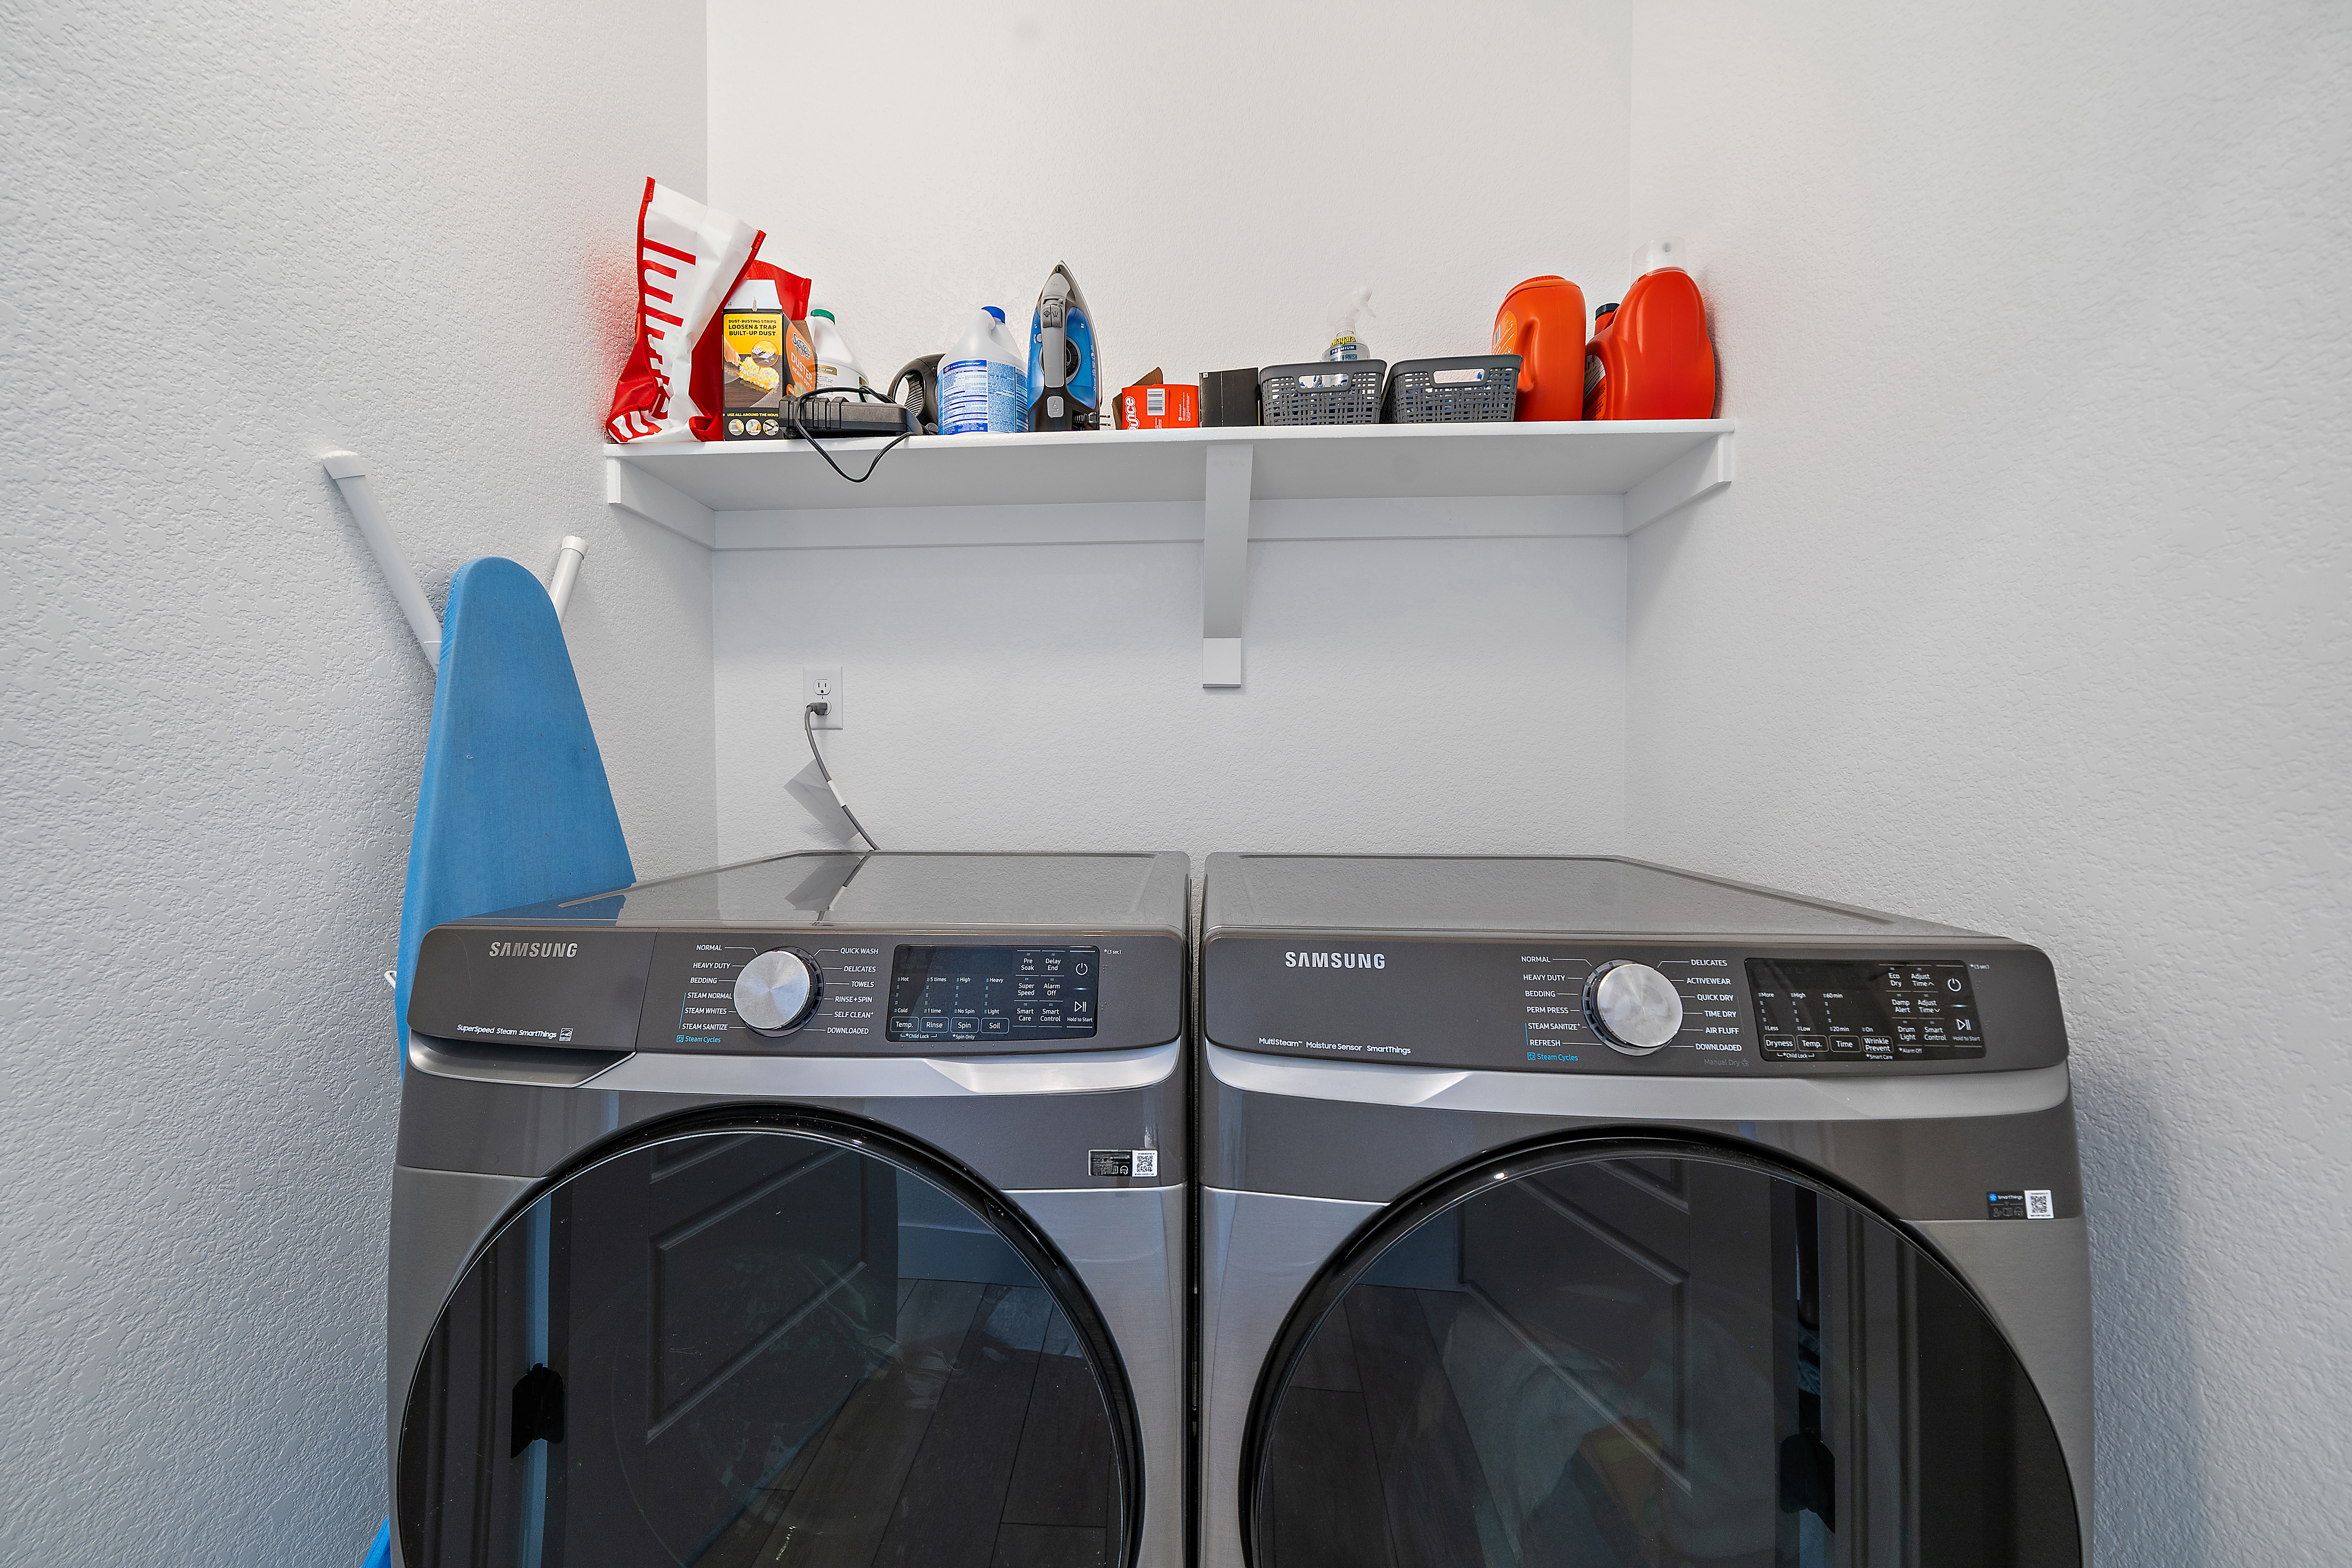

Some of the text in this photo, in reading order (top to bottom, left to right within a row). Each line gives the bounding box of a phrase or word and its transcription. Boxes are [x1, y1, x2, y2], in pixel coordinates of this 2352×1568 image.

[792, 332, 810, 359] Swiffer
[1330, 336, 1356, 348] Niagara
[791, 352, 812, 383] DUSTER
[792, 365, 804, 380] HEAVY
[1125, 397, 1139, 430] unce
[489, 942, 578, 958] SAMSUNG
[1285, 951, 1385, 969] SAMSUNG
[457, 1024, 557, 1040] SuperSpeed Steam SmartThings
[1306, 1041, 1337, 1050] Moisture
[1338, 1043, 1362, 1051] Sensor
[1367, 1045, 1411, 1055] SmartThings
[1695, 1043, 1742, 1051] DOWNLOADED
[1766, 1039, 1793, 1048] Dryness
[1802, 1040, 1822, 1049] Temp.
